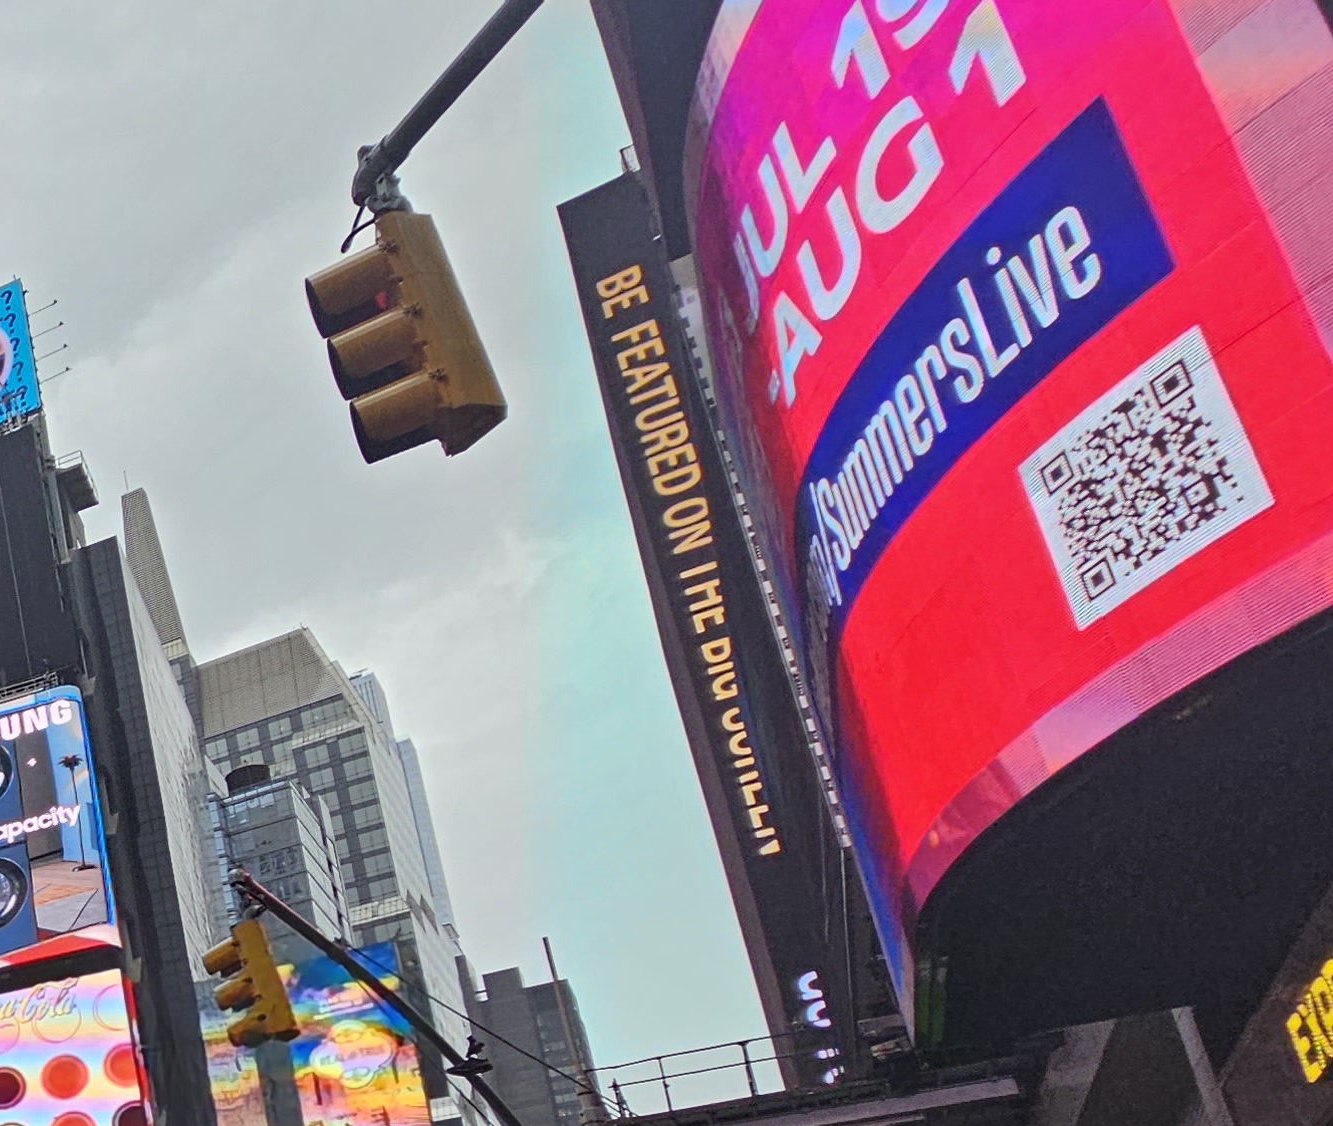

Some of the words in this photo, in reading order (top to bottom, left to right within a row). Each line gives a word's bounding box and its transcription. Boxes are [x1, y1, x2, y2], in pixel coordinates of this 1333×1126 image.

[595, 262, 649, 320] BE
[772, 95, 945, 410] AUG
[610, 317, 704, 500] FEATURED
[660, 495, 713, 556] ON
